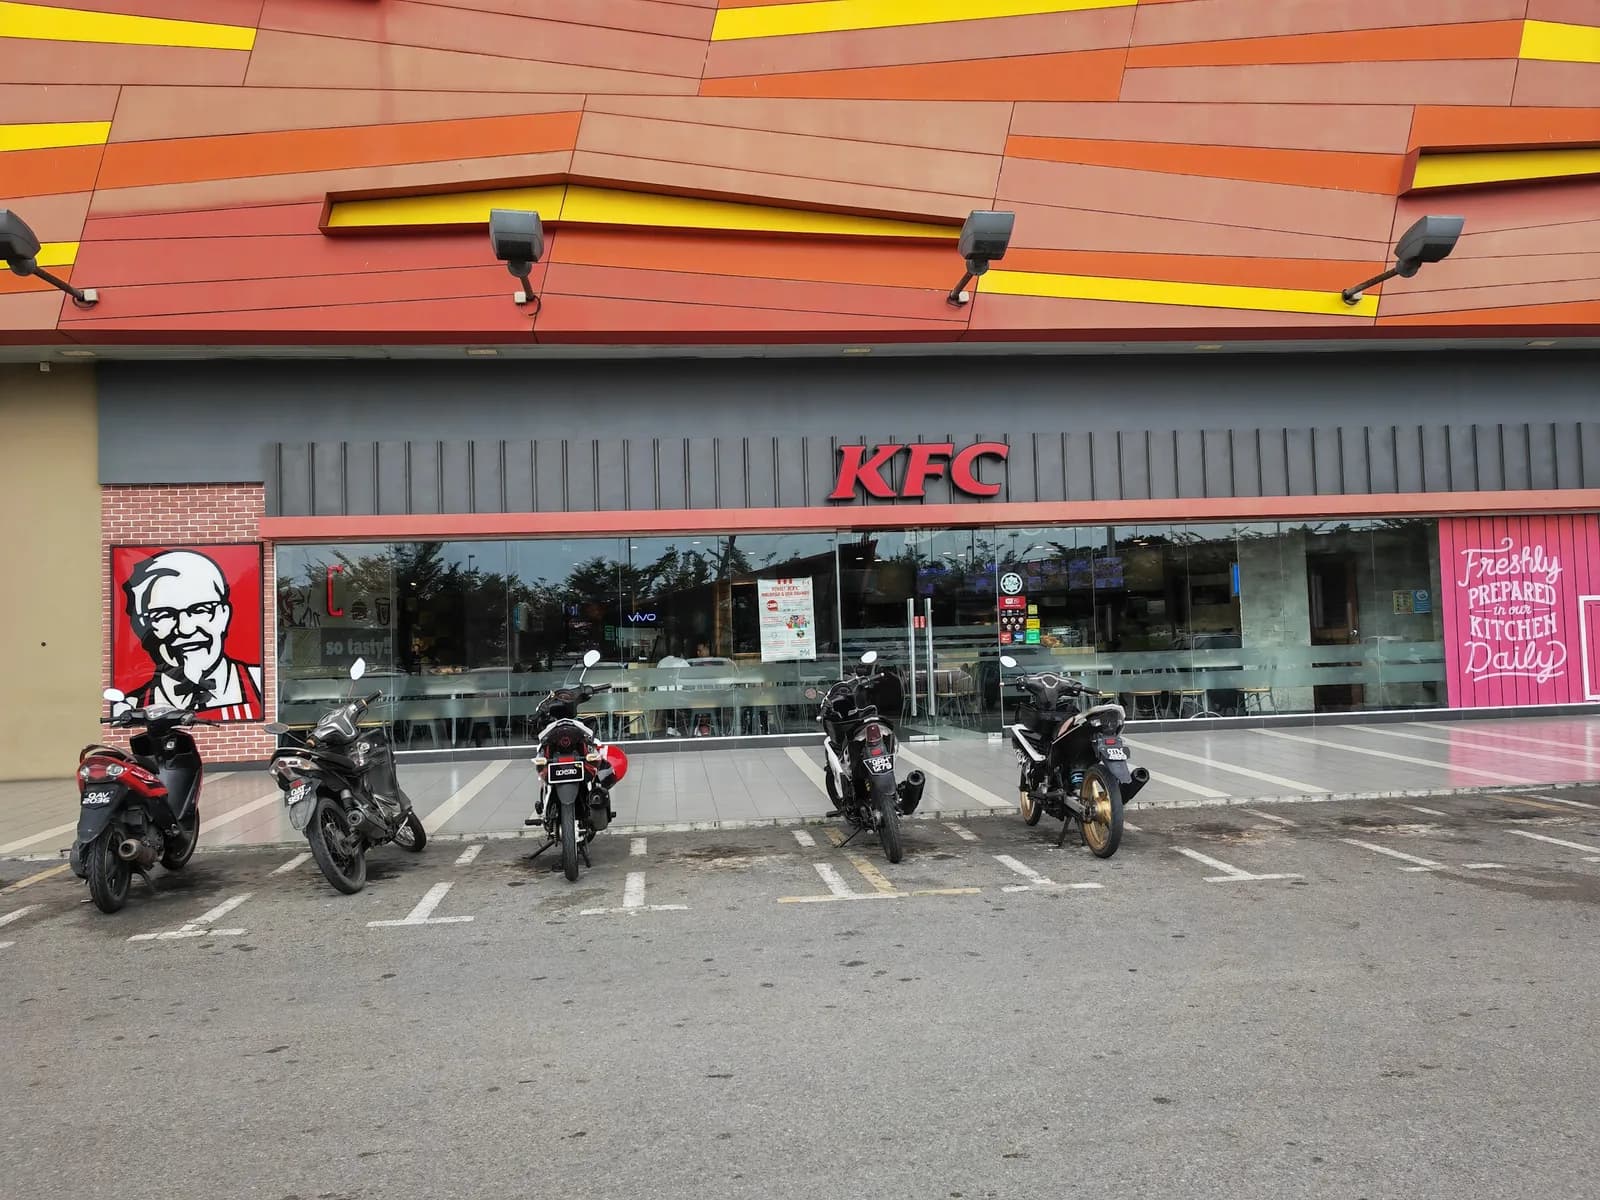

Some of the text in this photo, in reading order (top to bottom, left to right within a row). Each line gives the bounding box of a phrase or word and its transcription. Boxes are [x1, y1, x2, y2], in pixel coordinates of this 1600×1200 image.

[828, 441, 1011, 500] KFC
[1458, 537, 1563, 587] Freshly
[1468, 580, 1557, 609] PREPARED
[628, 612, 657, 622] vivo
[1493, 604, 1533, 616] in our
[1469, 612, 1558, 641] KITCHEN
[326, 641, 343, 656] so
[1464, 640, 1567, 684] Daily
